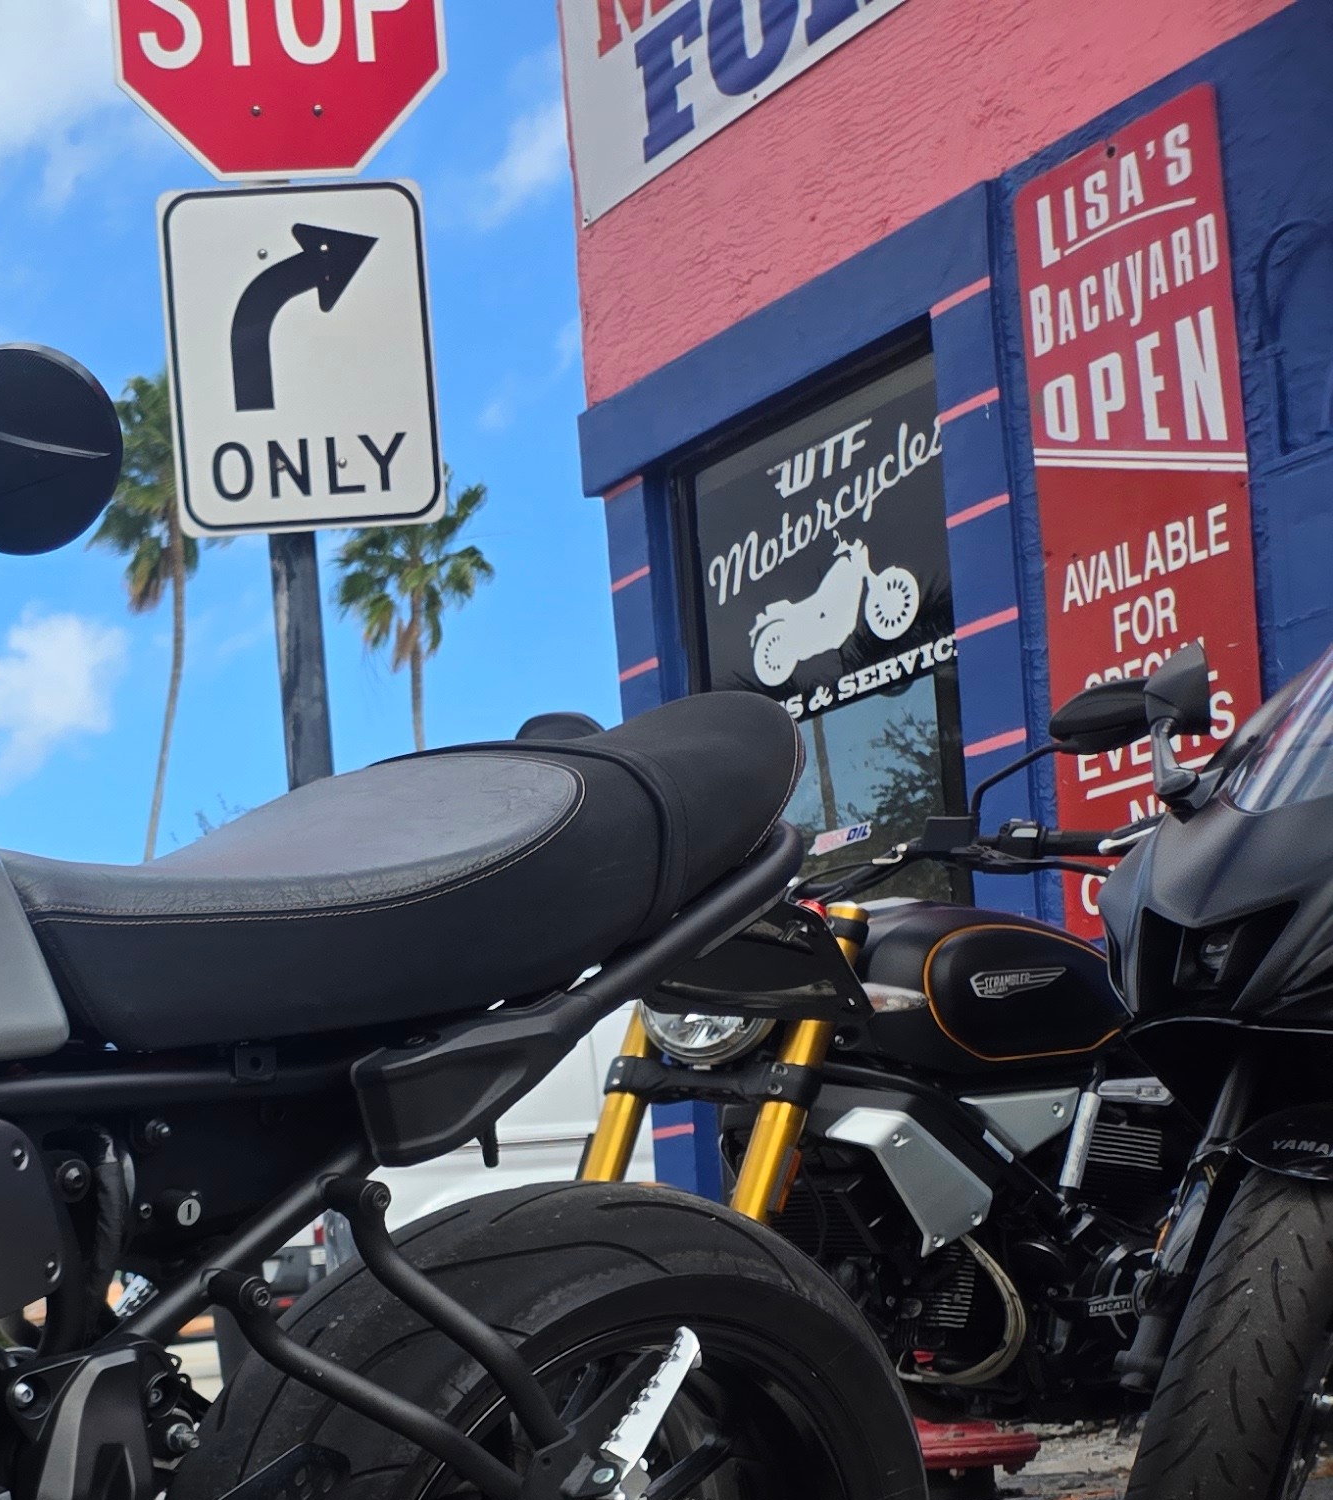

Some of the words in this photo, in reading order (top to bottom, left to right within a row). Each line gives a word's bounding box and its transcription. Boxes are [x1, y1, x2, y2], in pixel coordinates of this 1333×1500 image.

[138, 0, 403, 69] STOP
[1037, 123, 1192, 268] LISA'S
[1043, 306, 1228, 442] OPEN
[213, 432, 406, 501] ONLY
[766, 418, 872, 498] WTF
[1063, 503, 1229, 612] AVAILABLE
[1113, 587, 1177, 652] FOR
[808, 685, 833, 711] &
[838, 632, 958, 701] SERVIC
[984, 972, 1030, 989] SCRAMBLER
[1272, 1140, 1333, 1157] YAMA
[1089, 1300, 1131, 1313] DUCATI
